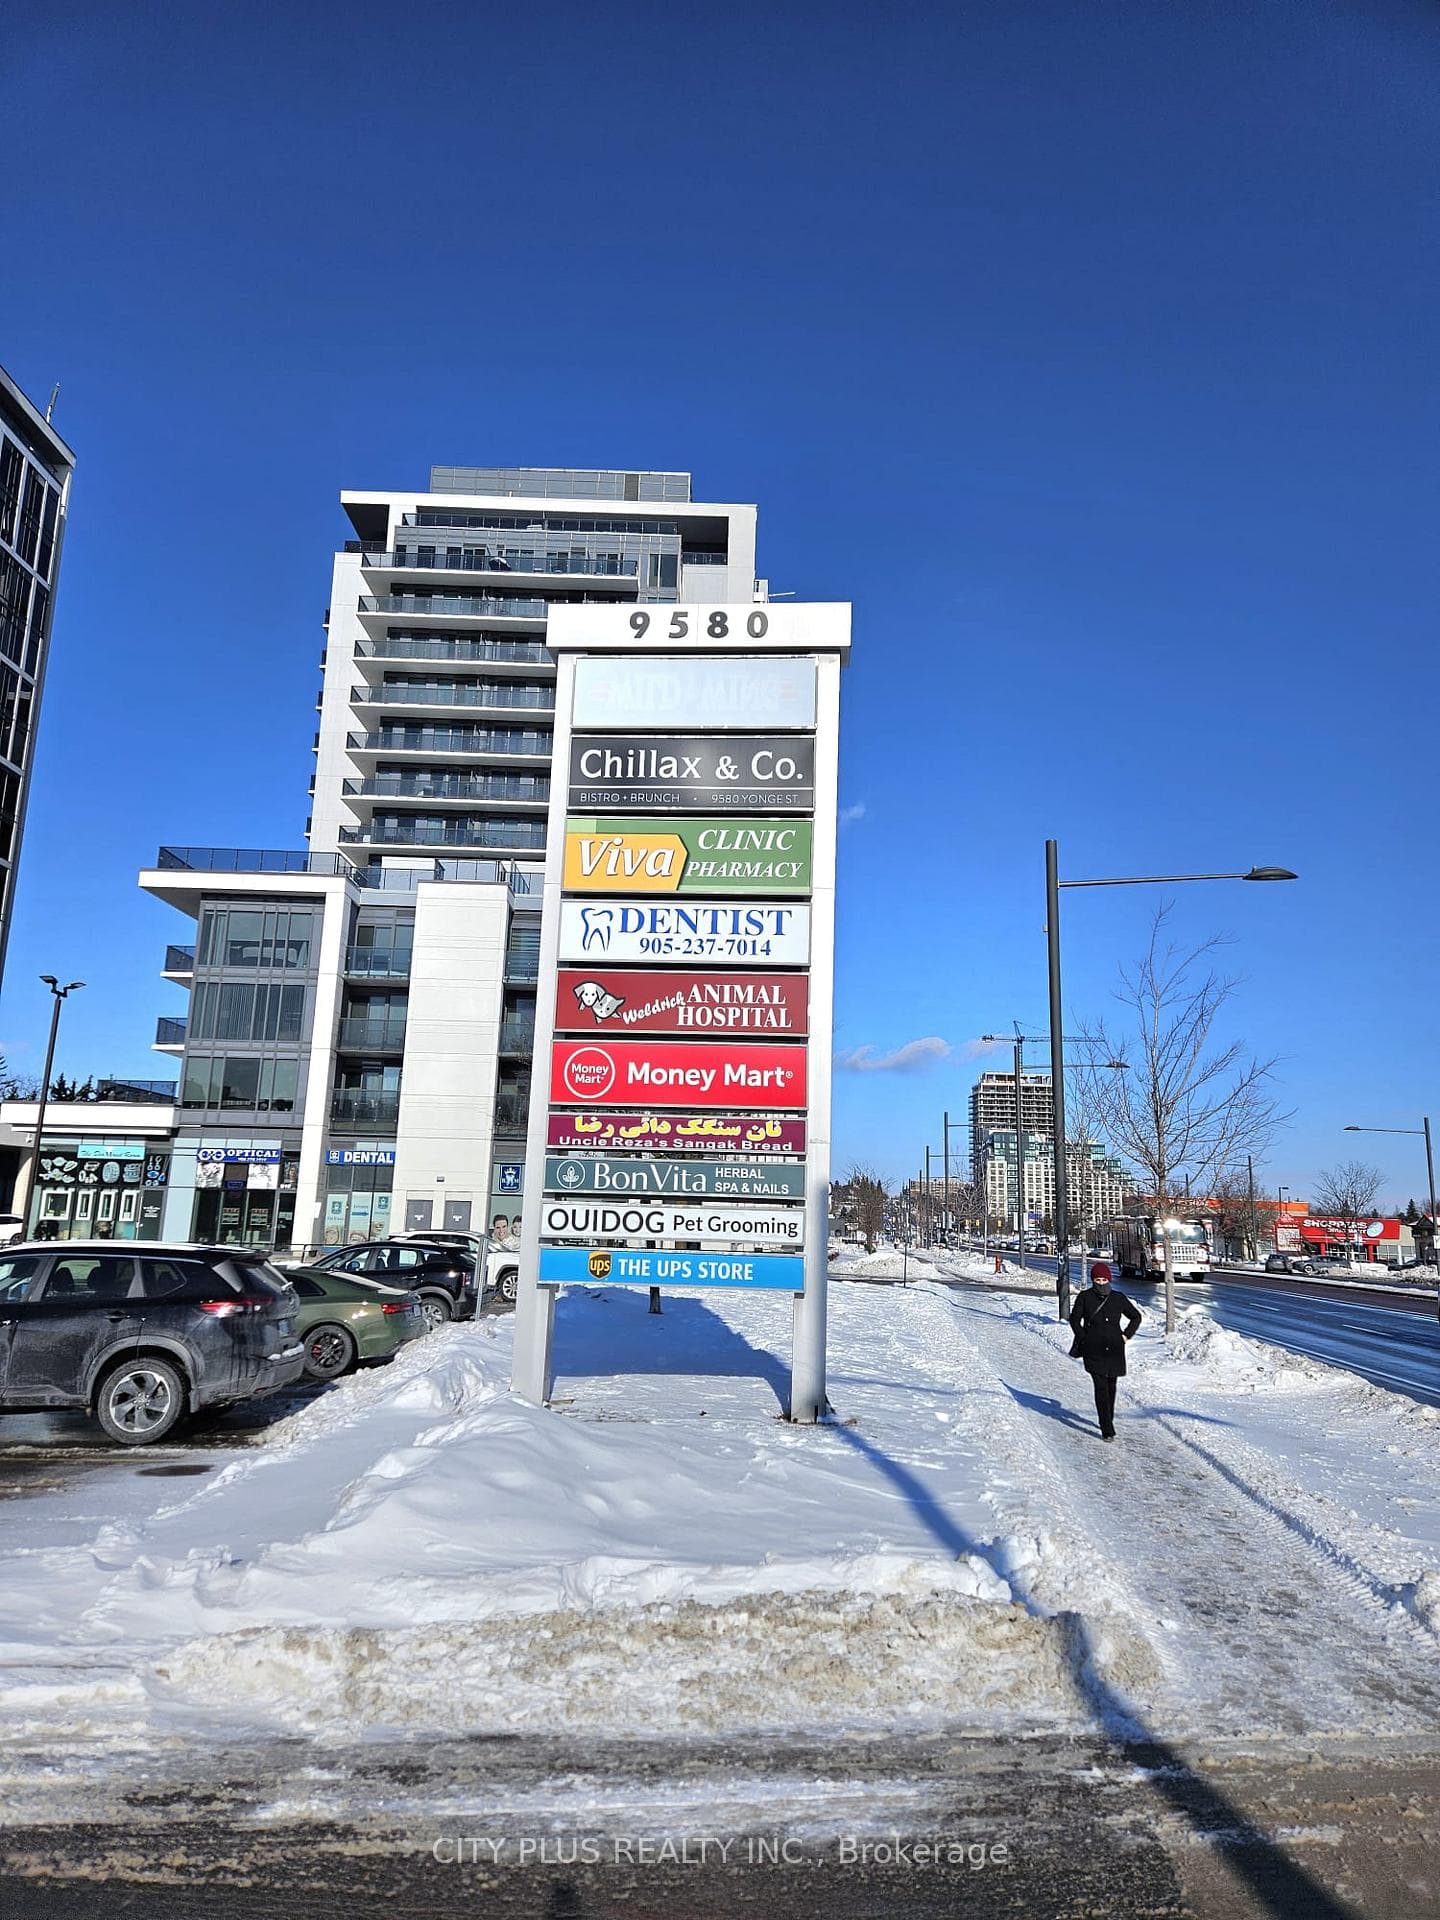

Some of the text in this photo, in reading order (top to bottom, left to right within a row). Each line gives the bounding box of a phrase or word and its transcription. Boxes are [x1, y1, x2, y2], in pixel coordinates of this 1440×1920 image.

[580, 749, 803, 780] Chillax & Co.
[580, 792, 619, 802] BISTRO
[630, 793, 680, 803] BRUNCH
[711, 794, 738, 804] 9580
[741, 795, 783, 804] YONGE
[698, 829, 796, 851] CLINIC
[578, 836, 675, 877] Viva
[686, 861, 803, 878] PHARMACY
[619, 907, 792, 937] DENTIST
[639, 937, 771, 956] 905-237-7014
[687, 984, 786, 1005] ANIMAL
[622, 991, 687, 1025] Weldrich
[676, 1006, 792, 1028] HOSPITAL
[571, 1063, 609, 1075] Money
[627, 1062, 715, 1091] Money
[574, 1116, 614, 1138] رضا
[745, 1119, 782, 1142] نان
[226, 1148, 279, 1158] OPTICAL
[559, 1136, 793, 1151] Uncle Reza's Sangak Bread
[343, 1151, 394, 1163] DENTAL
[593, 1162, 707, 1192] BonVita
[715, 1168, 765, 1179] HERBAL
[714, 1182, 789, 1194] SPA & NAILS
[547, 1208, 799, 1238] OUIDOG Pet Grooming
[589, 1259, 611, 1273] ups
[619, 1258, 754, 1281] THE UPS STORE
